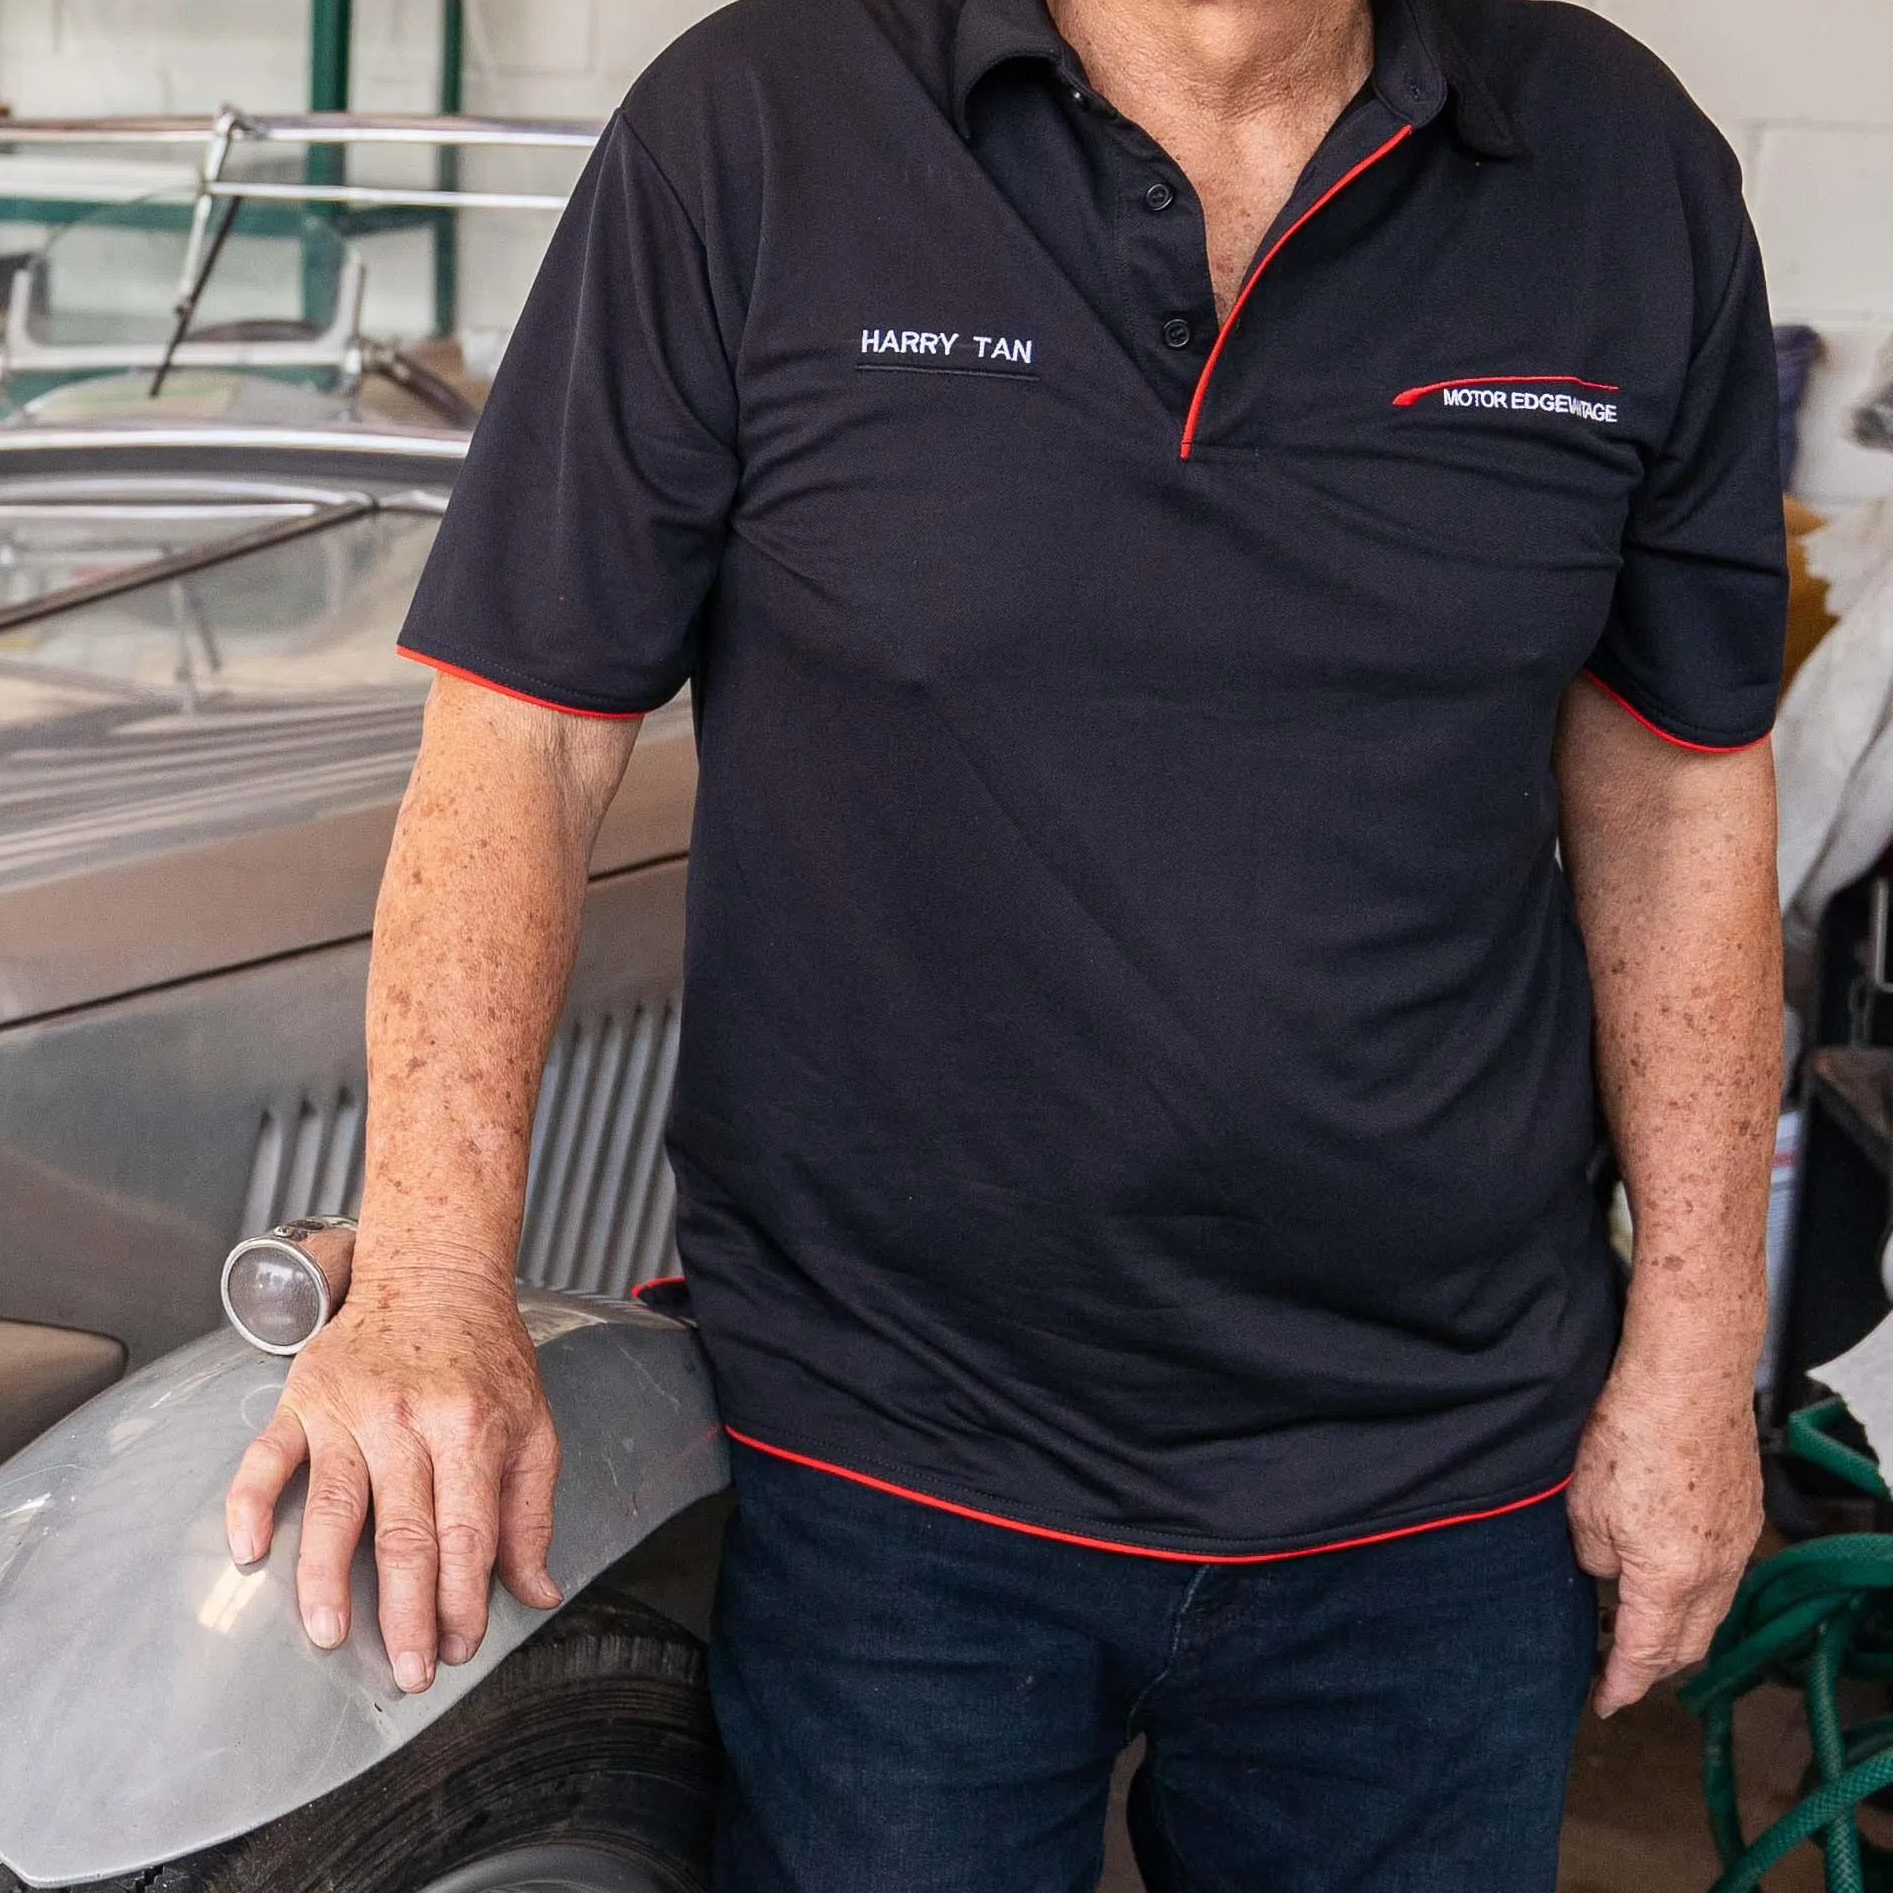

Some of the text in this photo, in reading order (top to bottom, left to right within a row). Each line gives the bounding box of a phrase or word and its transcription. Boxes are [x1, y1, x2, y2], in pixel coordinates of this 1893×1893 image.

[860, 328, 1033, 365] HARRY TAN
[1442, 387, 1509, 409] MOTOR
